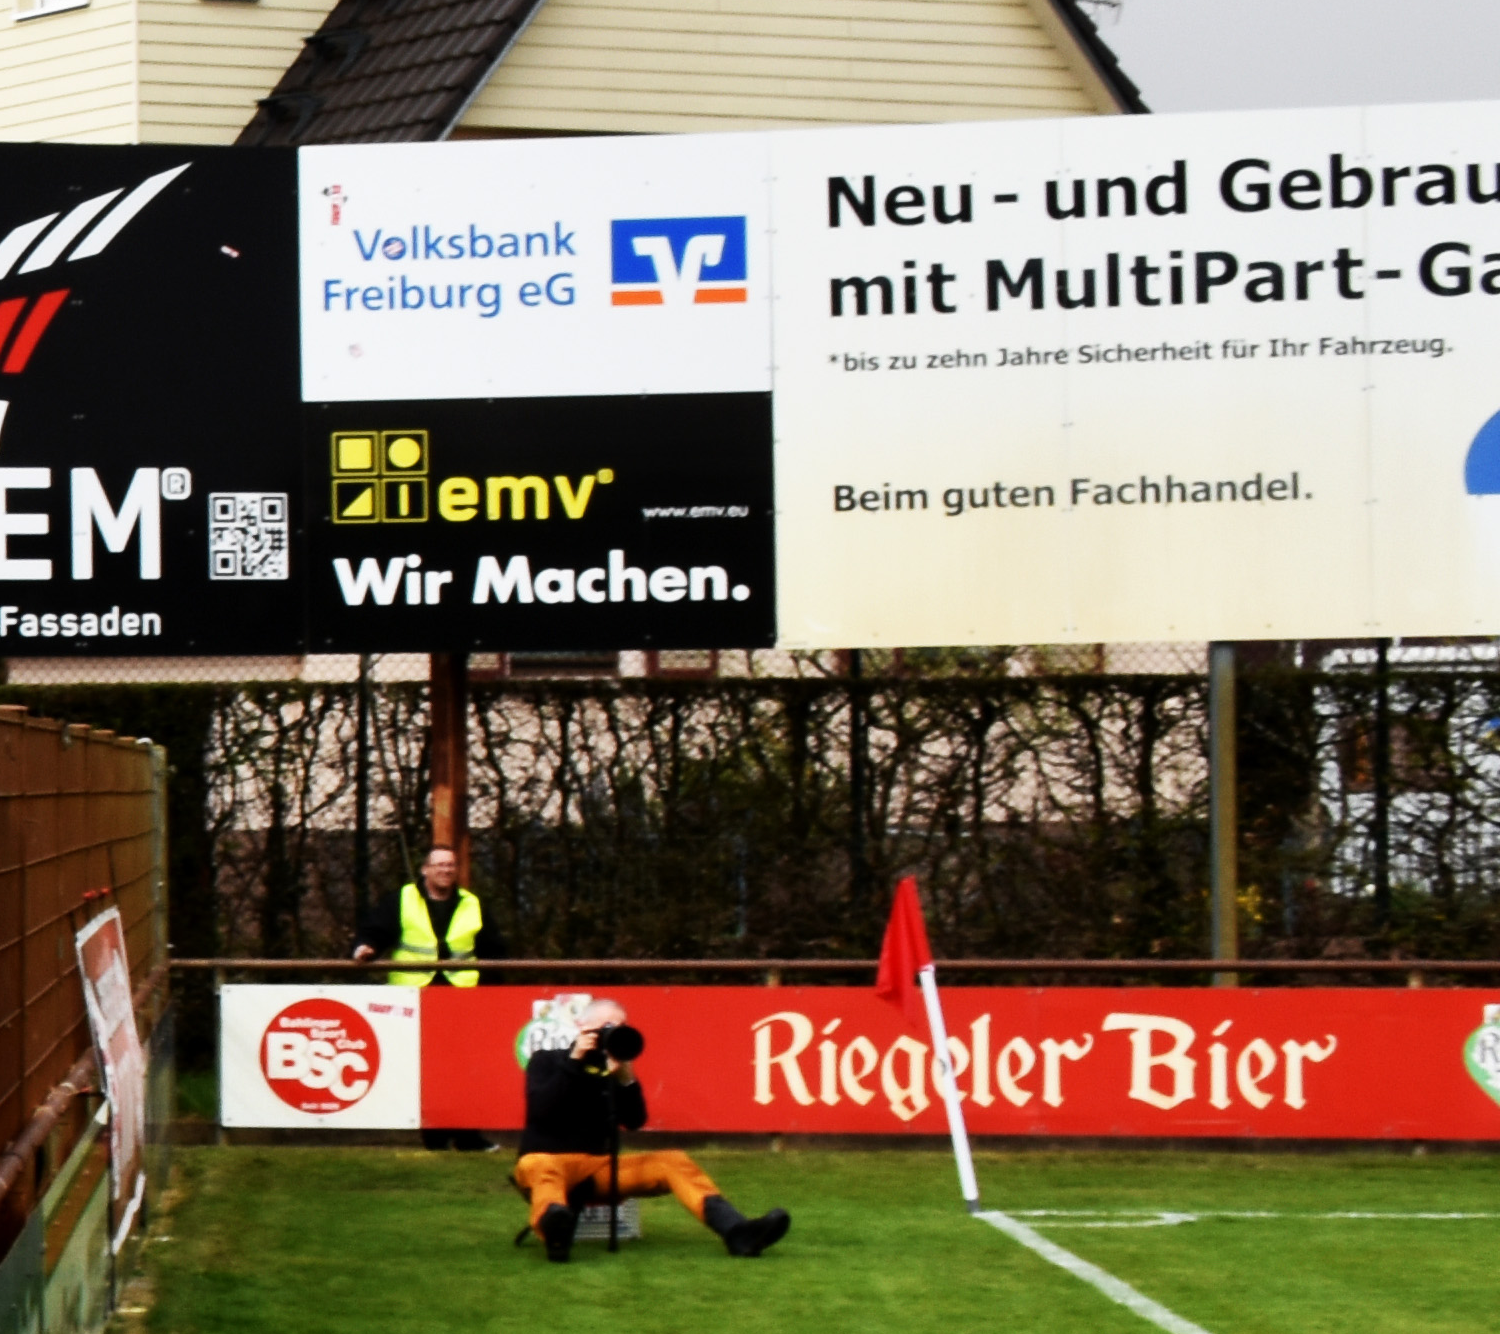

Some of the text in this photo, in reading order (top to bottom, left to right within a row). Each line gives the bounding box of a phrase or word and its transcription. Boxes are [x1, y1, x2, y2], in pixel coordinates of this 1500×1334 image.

[1045, 159, 1188, 220] und
[353, 222, 577, 262] Volksbank
[323, 272, 576, 319] Freiburg eG
[830, 260, 957, 317] mit
[888, 355, 917, 370] zu
[926, 351, 988, 369] zehn
[997, 346, 1070, 368] Jahre
[1077, 342, 1213, 365] Sicherheit
[1222, 339, 1260, 359] für
[1269, 338, 1309, 358] Ihr
[1318, 334, 1454, 361] Fahrzeug.
[833, 471, 1314, 517] Beim guten Fachhandel.
[333, 549, 750, 606] Wir Machen.
[0, 605, 162, 638] Fassaden
[266, 1031, 370, 1102] BSC
[1101, 1012, 1337, 1111] Bier
